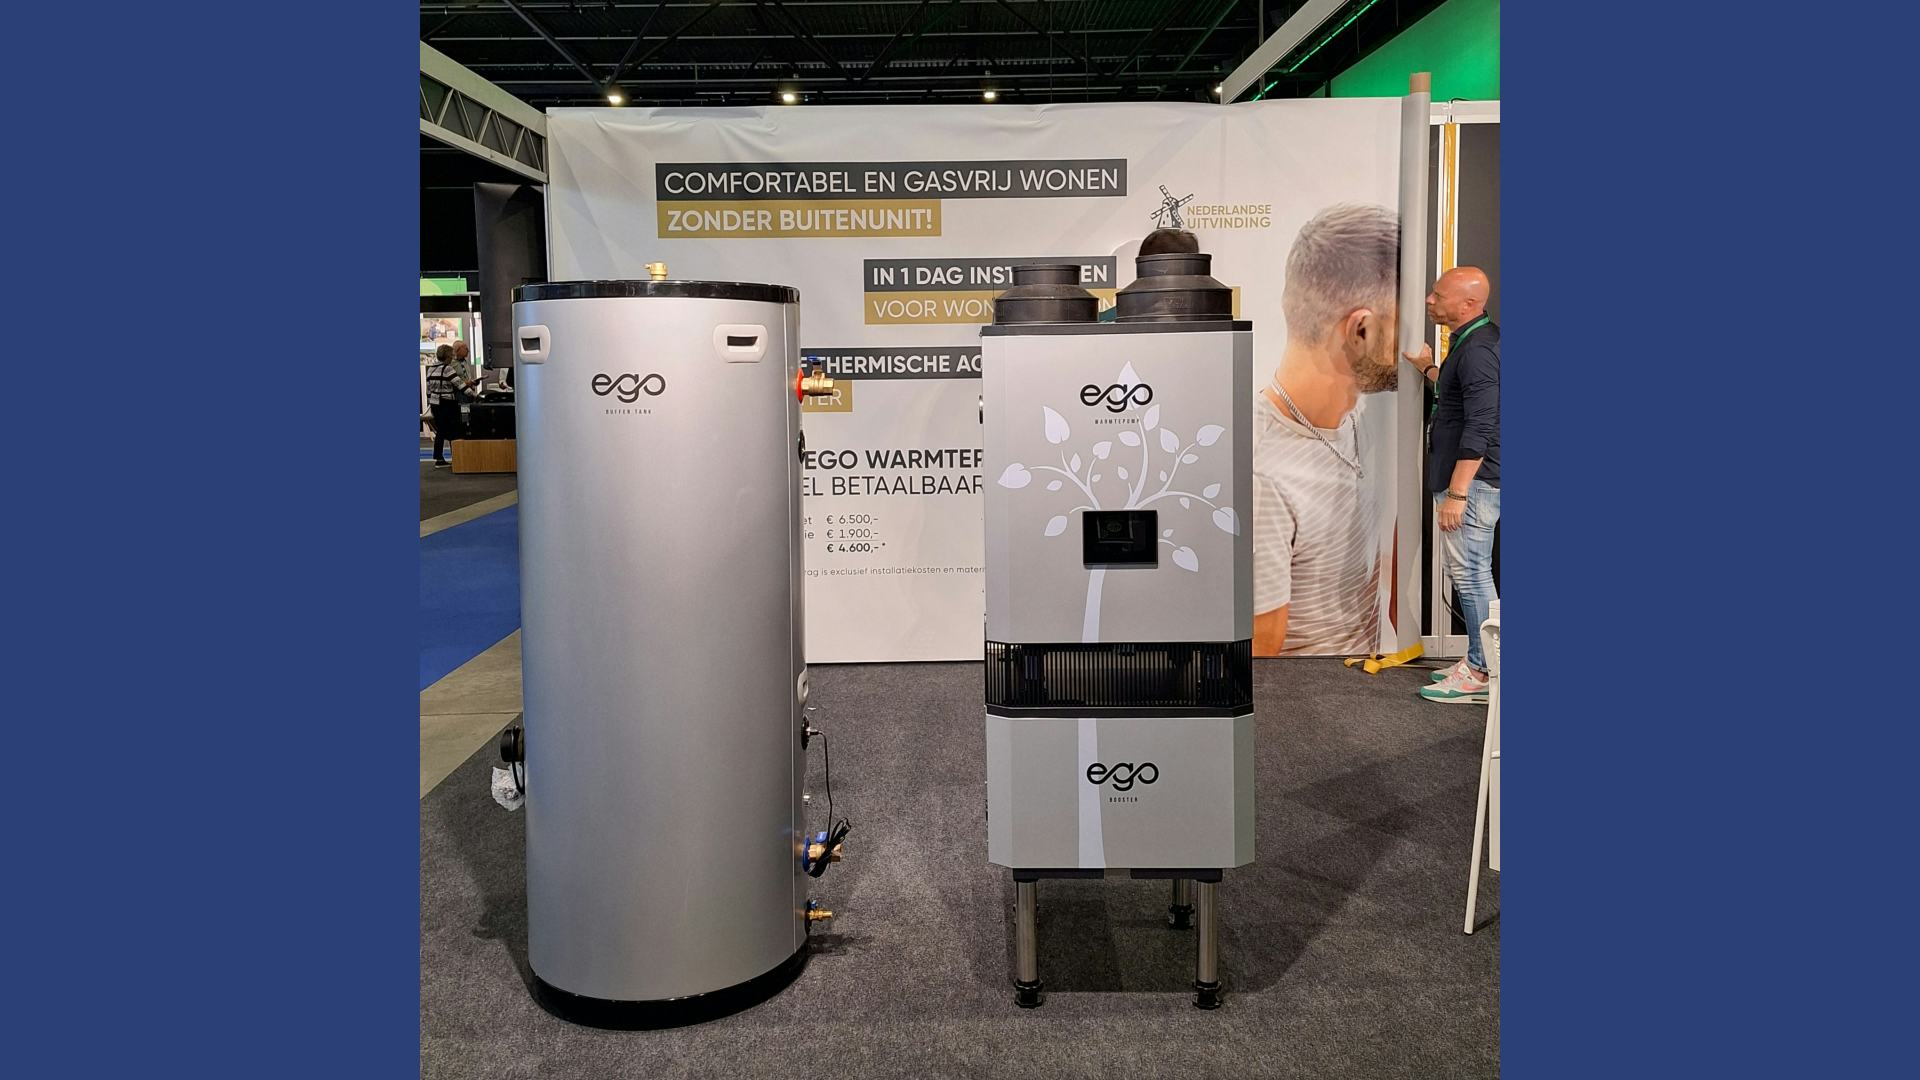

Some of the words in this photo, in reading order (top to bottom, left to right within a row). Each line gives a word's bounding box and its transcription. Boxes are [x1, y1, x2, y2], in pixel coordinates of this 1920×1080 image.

[664, 171, 856, 194] COMFORTABEL
[864, 171, 896, 193] EN
[903, 169, 1011, 192] GASVRIJ
[1020, 168, 1119, 191] WONEN
[1187, 204, 1272, 216] NEDERLANDSE
[667, 210, 773, 232] ZONDER
[779, 208, 933, 231] BUITENUNIT!
[1187, 216, 1271, 229] UITVINDING
[873, 267, 894, 285] IN
[900, 267, 909, 285] 1
[916, 266, 964, 285] DAG
[873, 299, 937, 318] VOOR
[591, 373, 666, 403] ego
[1080, 383, 1154, 413] ego
[805, 449, 858, 470] EGO
[839, 514, 879, 525] 6.500,-
[839, 528, 879, 539] 1.900,-
[821, 567, 828, 576] is
[830, 567, 868, 576] exclusief
[871, 565, 941, 575] installatiekosten
[1086, 762, 1159, 791] ego
